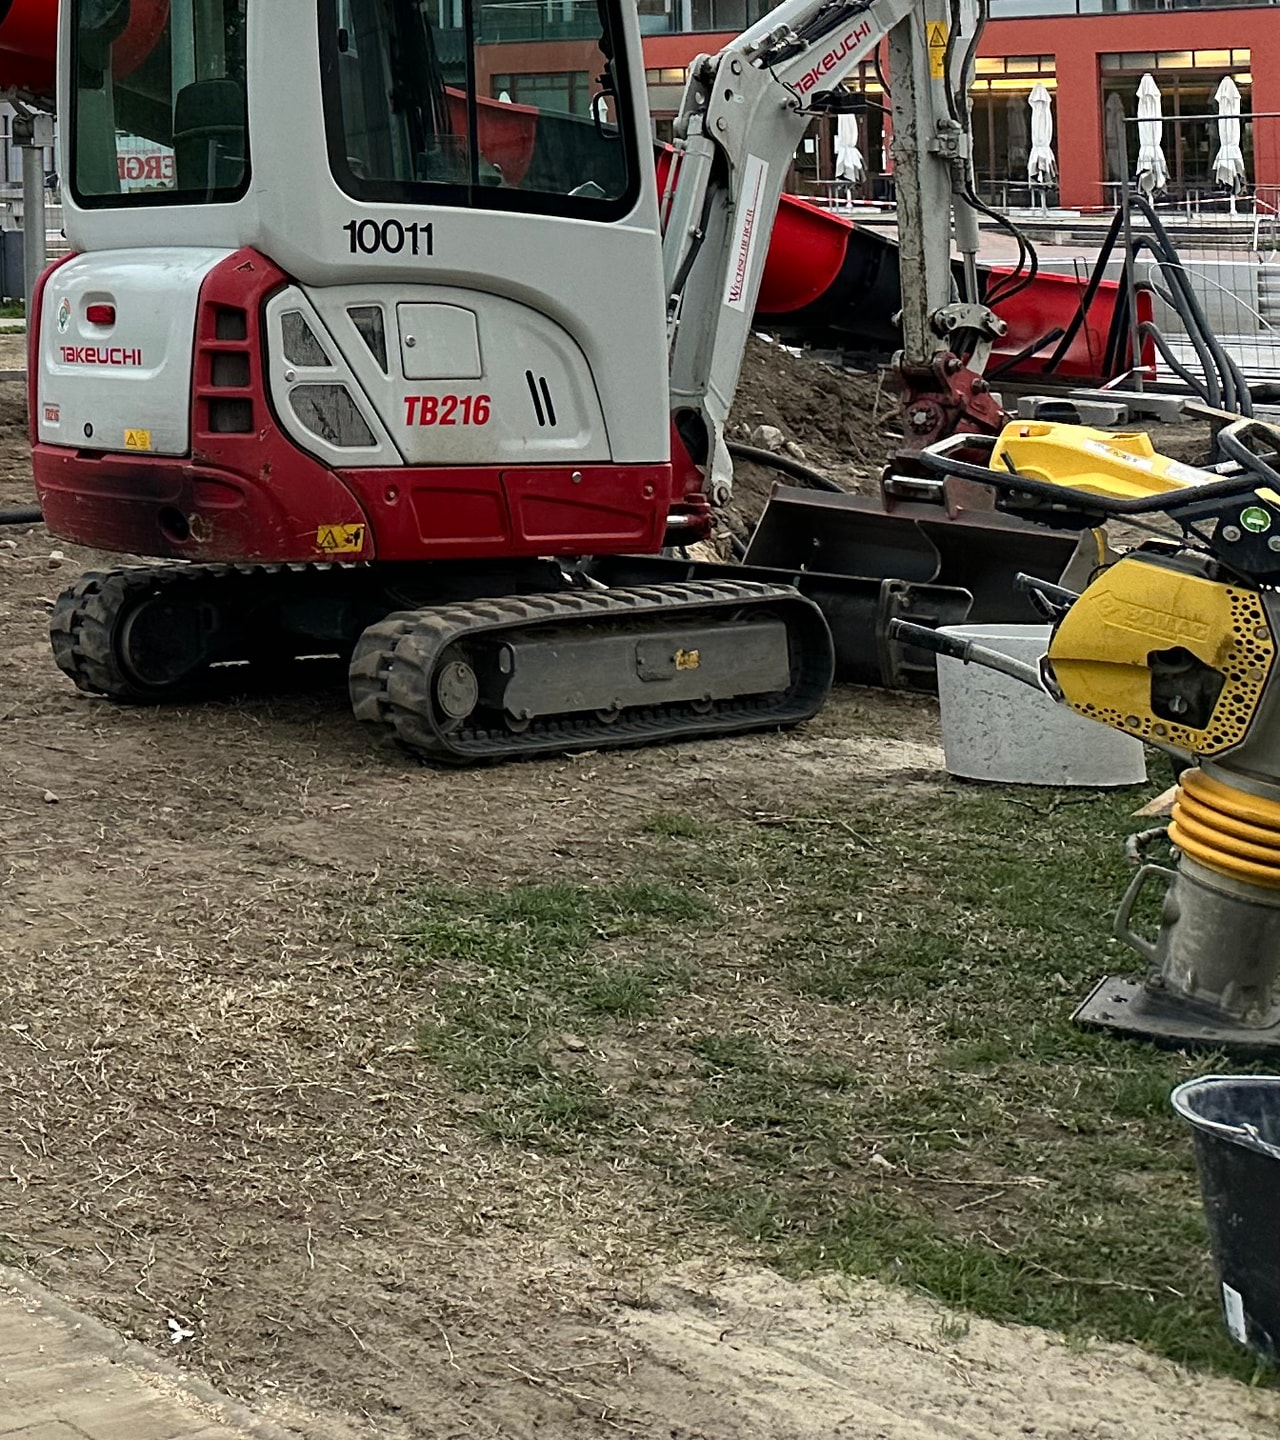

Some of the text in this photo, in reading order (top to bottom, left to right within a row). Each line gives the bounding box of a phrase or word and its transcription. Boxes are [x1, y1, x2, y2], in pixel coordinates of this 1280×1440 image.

[793, 20, 871, 95] TAKEUCHI
[343, 219, 433, 256] 10011
[60, 346, 142, 366] TAKEUCHI
[404, 394, 491, 426] TB216
